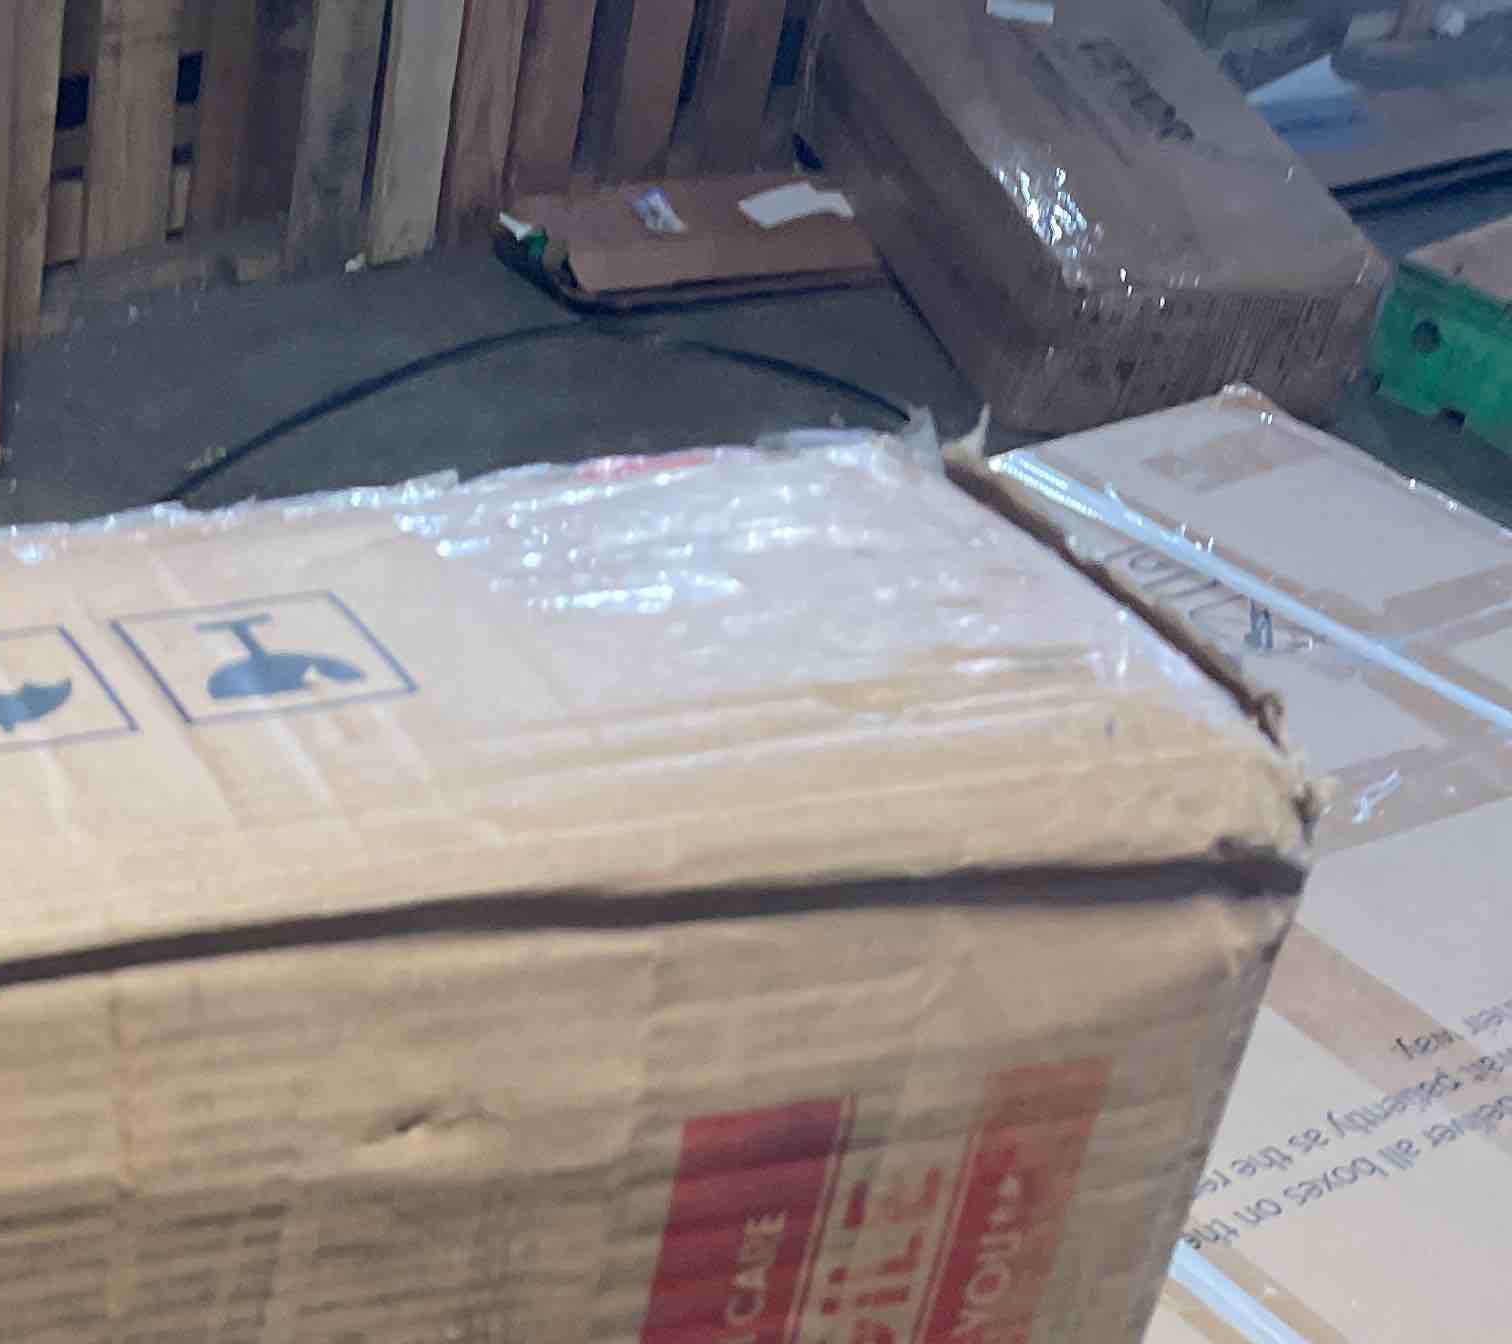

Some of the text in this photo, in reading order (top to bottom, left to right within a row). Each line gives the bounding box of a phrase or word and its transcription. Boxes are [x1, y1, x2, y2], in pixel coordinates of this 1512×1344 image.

[1283, 1155, 1390, 1207] boxes
[1234, 1197, 1283, 1229] on
[727, 1211, 788, 1323] CARE
